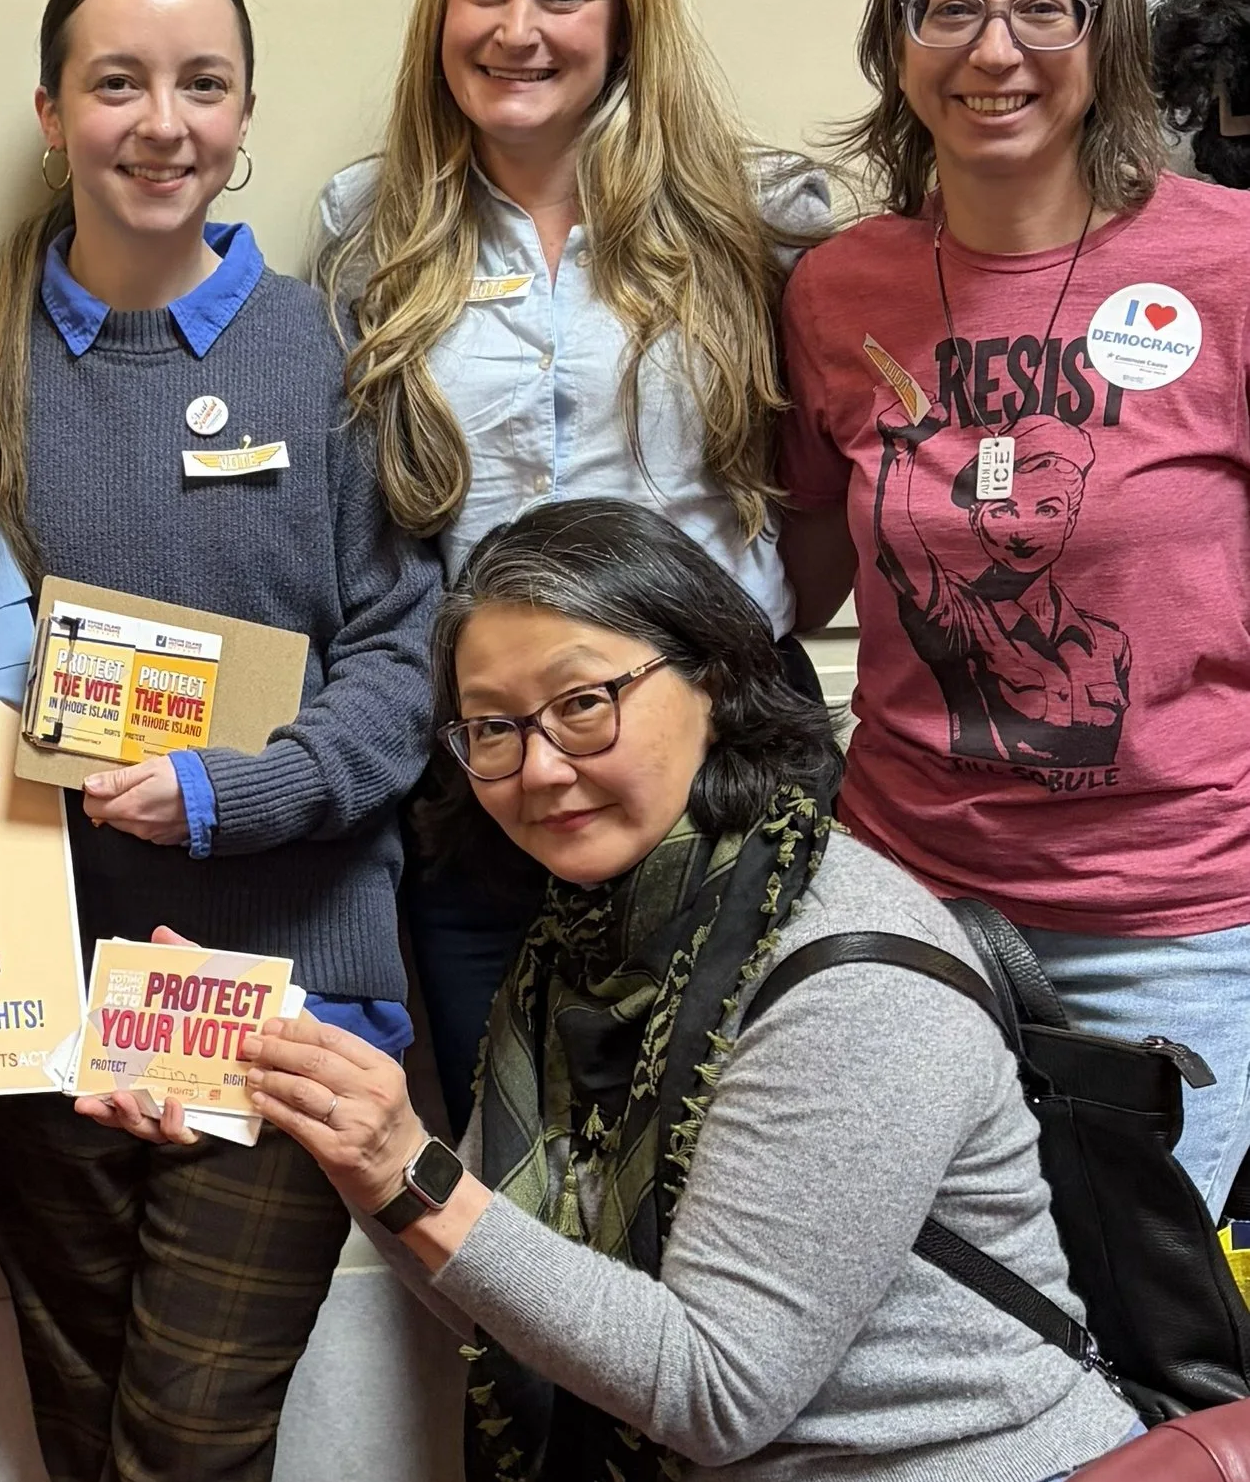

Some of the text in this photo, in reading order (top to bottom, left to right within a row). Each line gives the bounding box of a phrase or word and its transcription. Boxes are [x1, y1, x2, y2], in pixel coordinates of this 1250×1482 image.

[1125, 299, 1140, 327] I
[1091, 328, 1195, 357] DEMOCRACY
[992, 451, 1011, 491] ICE
[56, 648, 125, 683] PROTECT
[138, 665, 207, 699] PROTECT
[53, 671, 123, 706] THE VOTE
[135, 687, 206, 722] THE VOTE
[48, 697, 57, 709] IN
[89, 704, 119, 722] ISLAND
[131, 713, 202, 737] IN RHODE ISLAND
[144, 971, 272, 1019] PROTECT
[102, 1008, 258, 1063] YOUR VOTE
[90, 1058, 127, 1073] PROTECT
